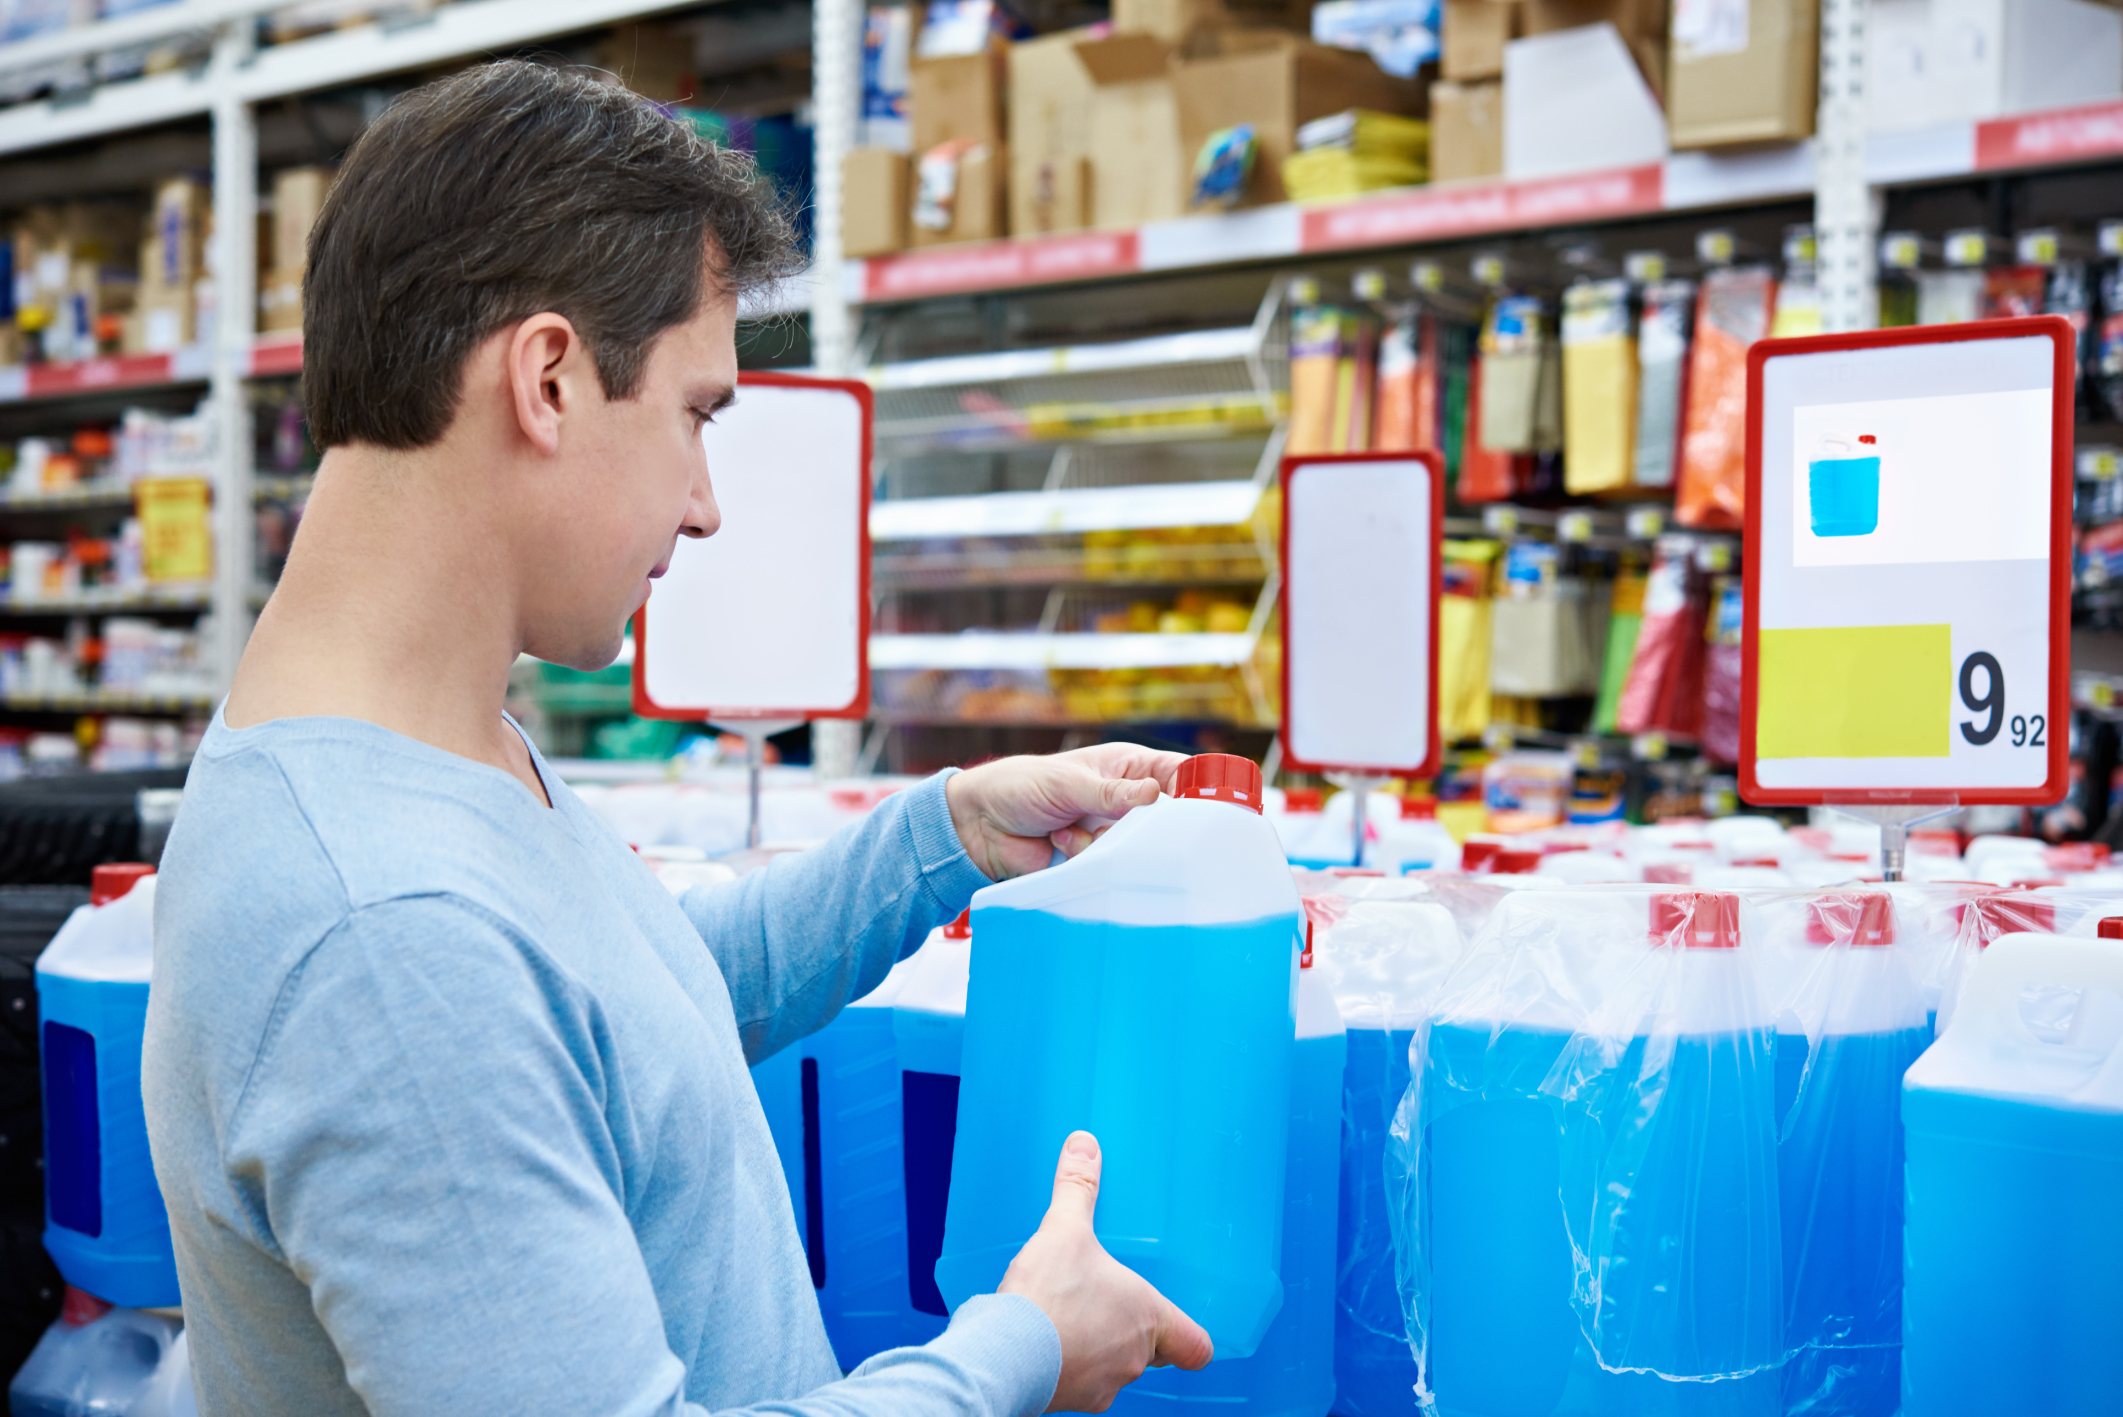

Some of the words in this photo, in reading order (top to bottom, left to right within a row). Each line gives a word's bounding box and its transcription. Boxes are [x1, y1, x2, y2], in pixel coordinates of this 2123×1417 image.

[1959, 651, 2005, 745] 9
[2011, 715, 2045, 747] 92
[1233, 1129, 1243, 1146] 2
